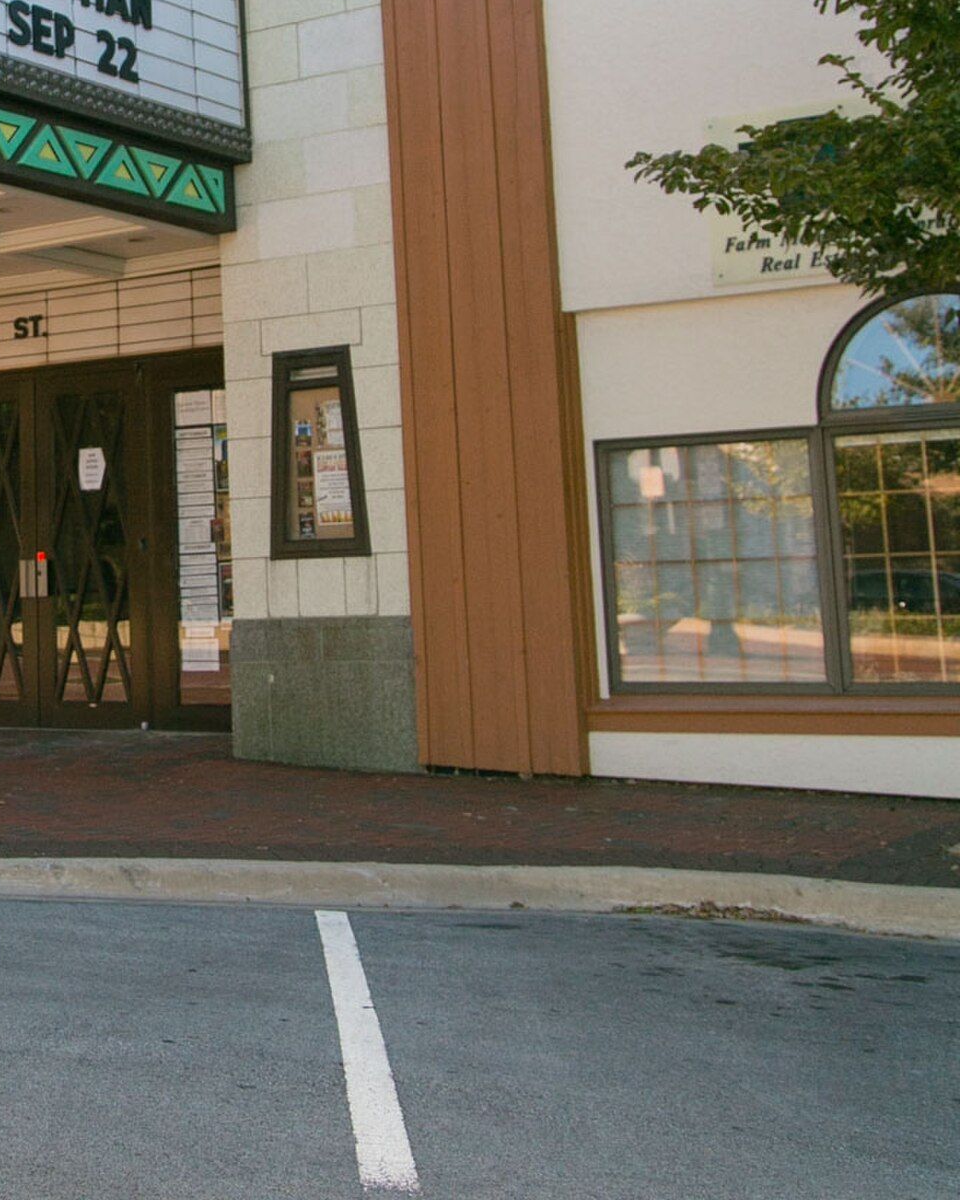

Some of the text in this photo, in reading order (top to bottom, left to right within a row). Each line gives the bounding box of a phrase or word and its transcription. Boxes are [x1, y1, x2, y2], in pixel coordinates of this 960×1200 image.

[8, 0, 139, 84] SEP 22
[761, 253, 800, 273] Real
[14, 314, 48, 340] ST.
